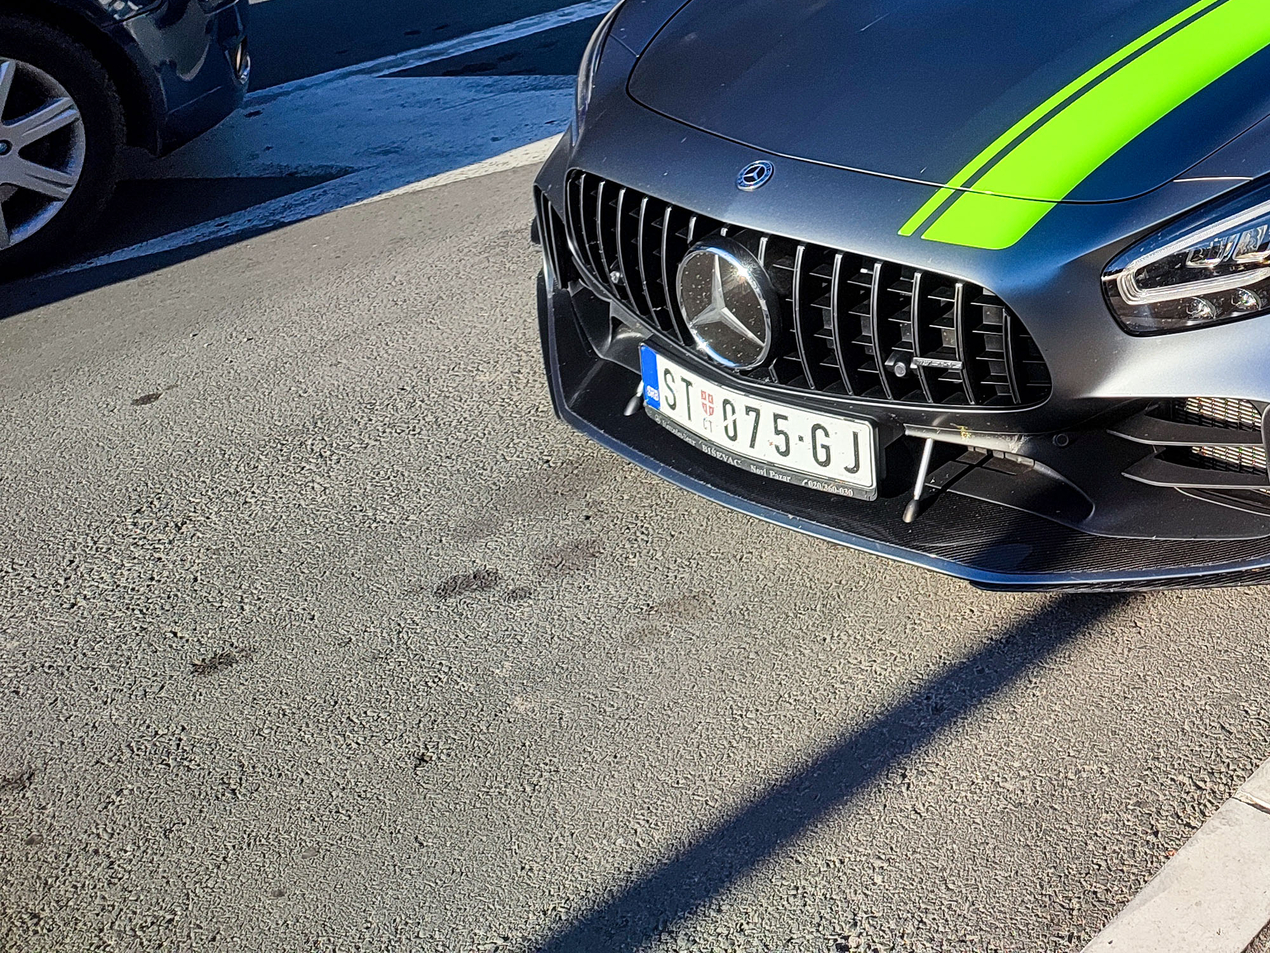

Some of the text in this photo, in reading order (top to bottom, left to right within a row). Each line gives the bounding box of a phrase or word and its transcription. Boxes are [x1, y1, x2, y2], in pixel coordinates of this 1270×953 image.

[663, 367, 694, 422] ST
[750, 464, 768, 477] Novi
[769, 470, 792, 483] Pazar
